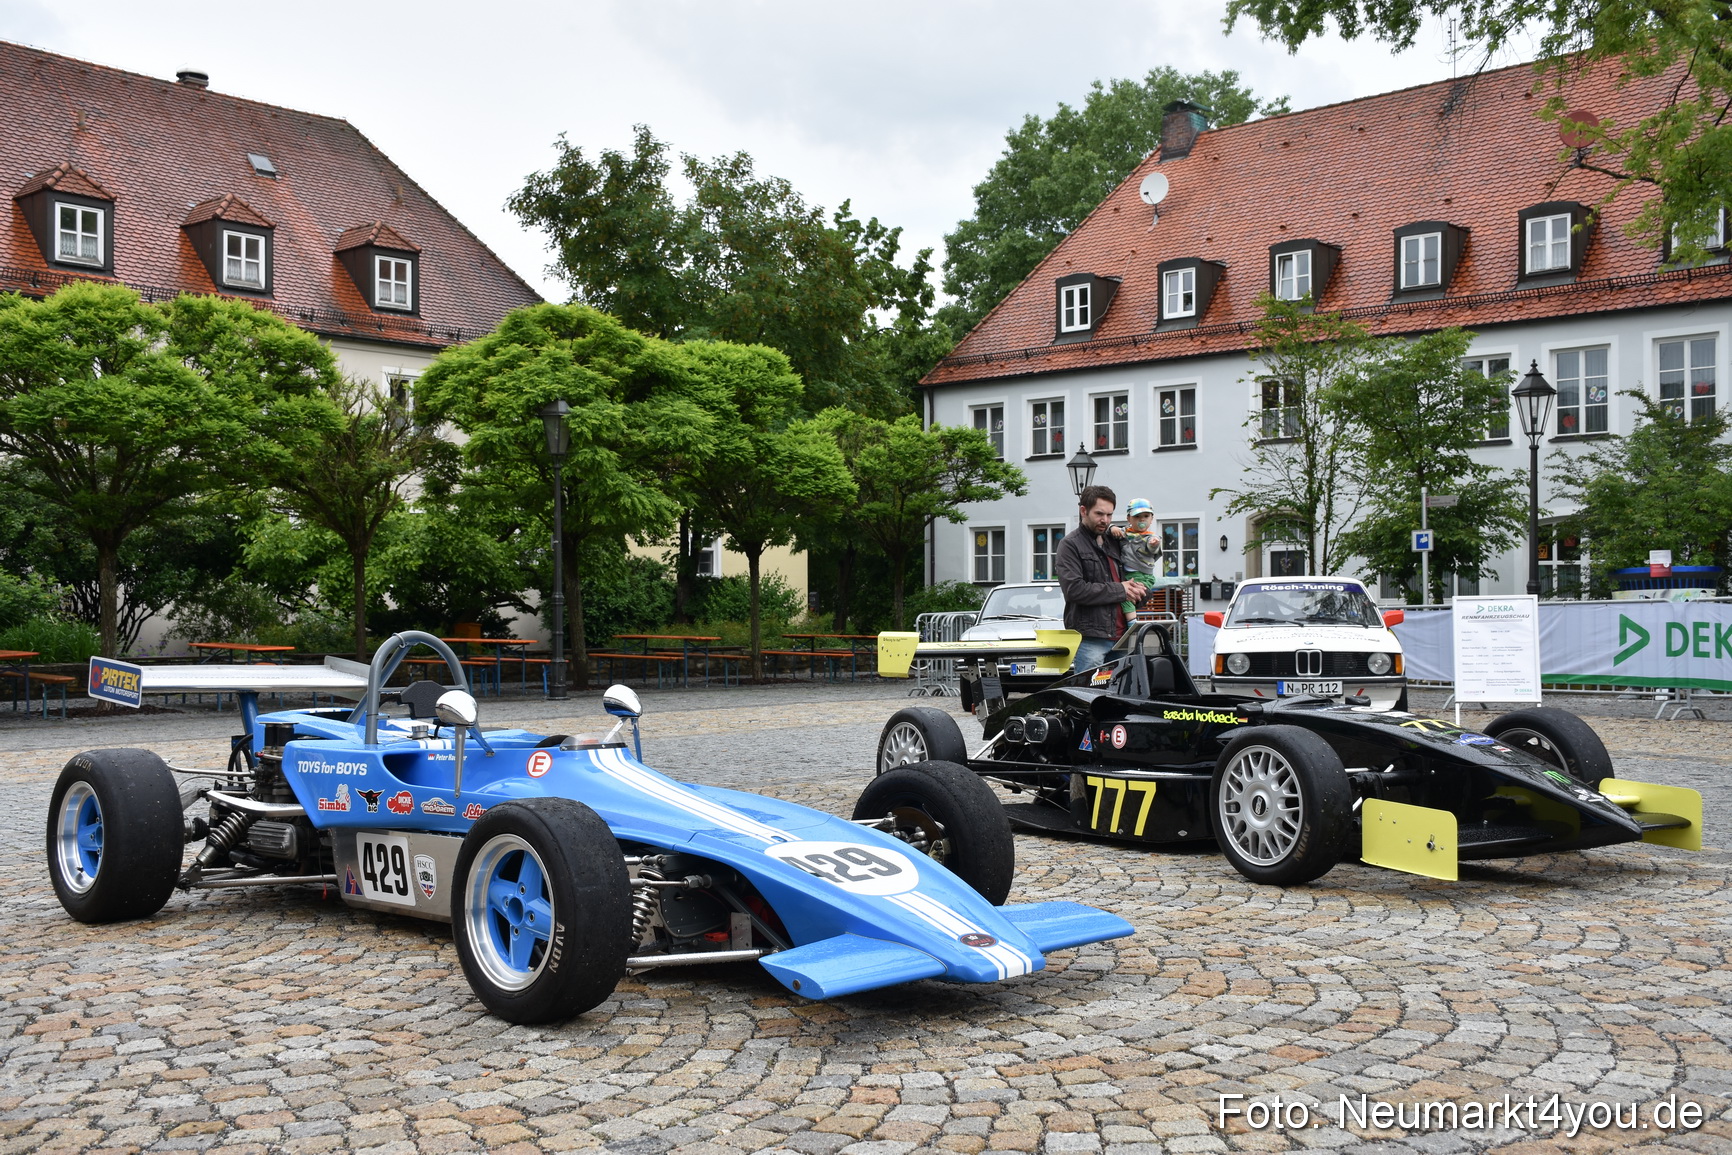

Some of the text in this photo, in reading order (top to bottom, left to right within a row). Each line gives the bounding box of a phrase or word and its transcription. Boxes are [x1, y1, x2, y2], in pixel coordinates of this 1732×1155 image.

[1016, 665, 1026, 673] NM
[100, 667, 140, 692] PIRTEK
[115, 688, 139, 699] MOTORSPORT
[1287, 683, 1338, 693] N PR 112
[1163, 708, 1194, 721] sascha
[1116, 730, 1122, 743] E
[435, 753, 448, 761] Peter
[297, 760, 367, 776] TOYS for BOYS
[532, 756, 546, 772] E
[318, 798, 347, 811] Simba
[368, 804, 378, 812] BIG
[1087, 776, 1156, 837] 777
[363, 842, 409, 896] 429
[417, 859, 433, 870] HSCC
[779, 847, 903, 883] 429
[549, 921, 566, 974] AVON
